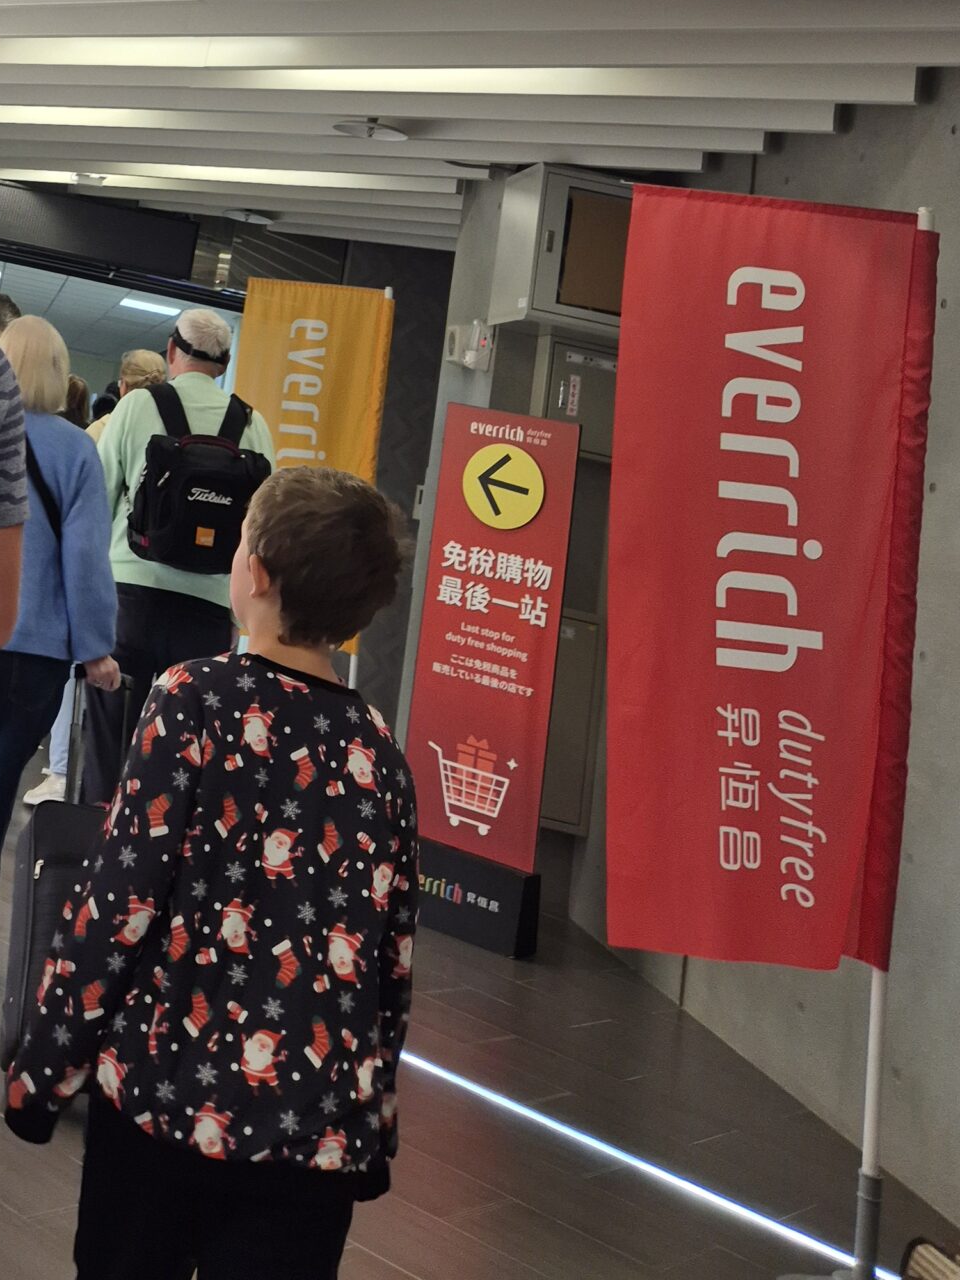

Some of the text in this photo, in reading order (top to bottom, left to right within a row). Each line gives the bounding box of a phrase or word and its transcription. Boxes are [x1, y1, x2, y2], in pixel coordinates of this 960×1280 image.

[276, 318, 328, 469] everri
[470, 421, 524, 442] everrich
[715, 266, 823, 672] everrich
[187, 487, 233, 506] Titleist
[441, 540, 553, 591] 免稅購物
[436, 575, 549, 628] 最後一站
[445, 632, 529, 663] duty free shopping
[460, 622, 516, 643] Last stop for
[767, 709, 827, 908] dutyfree
